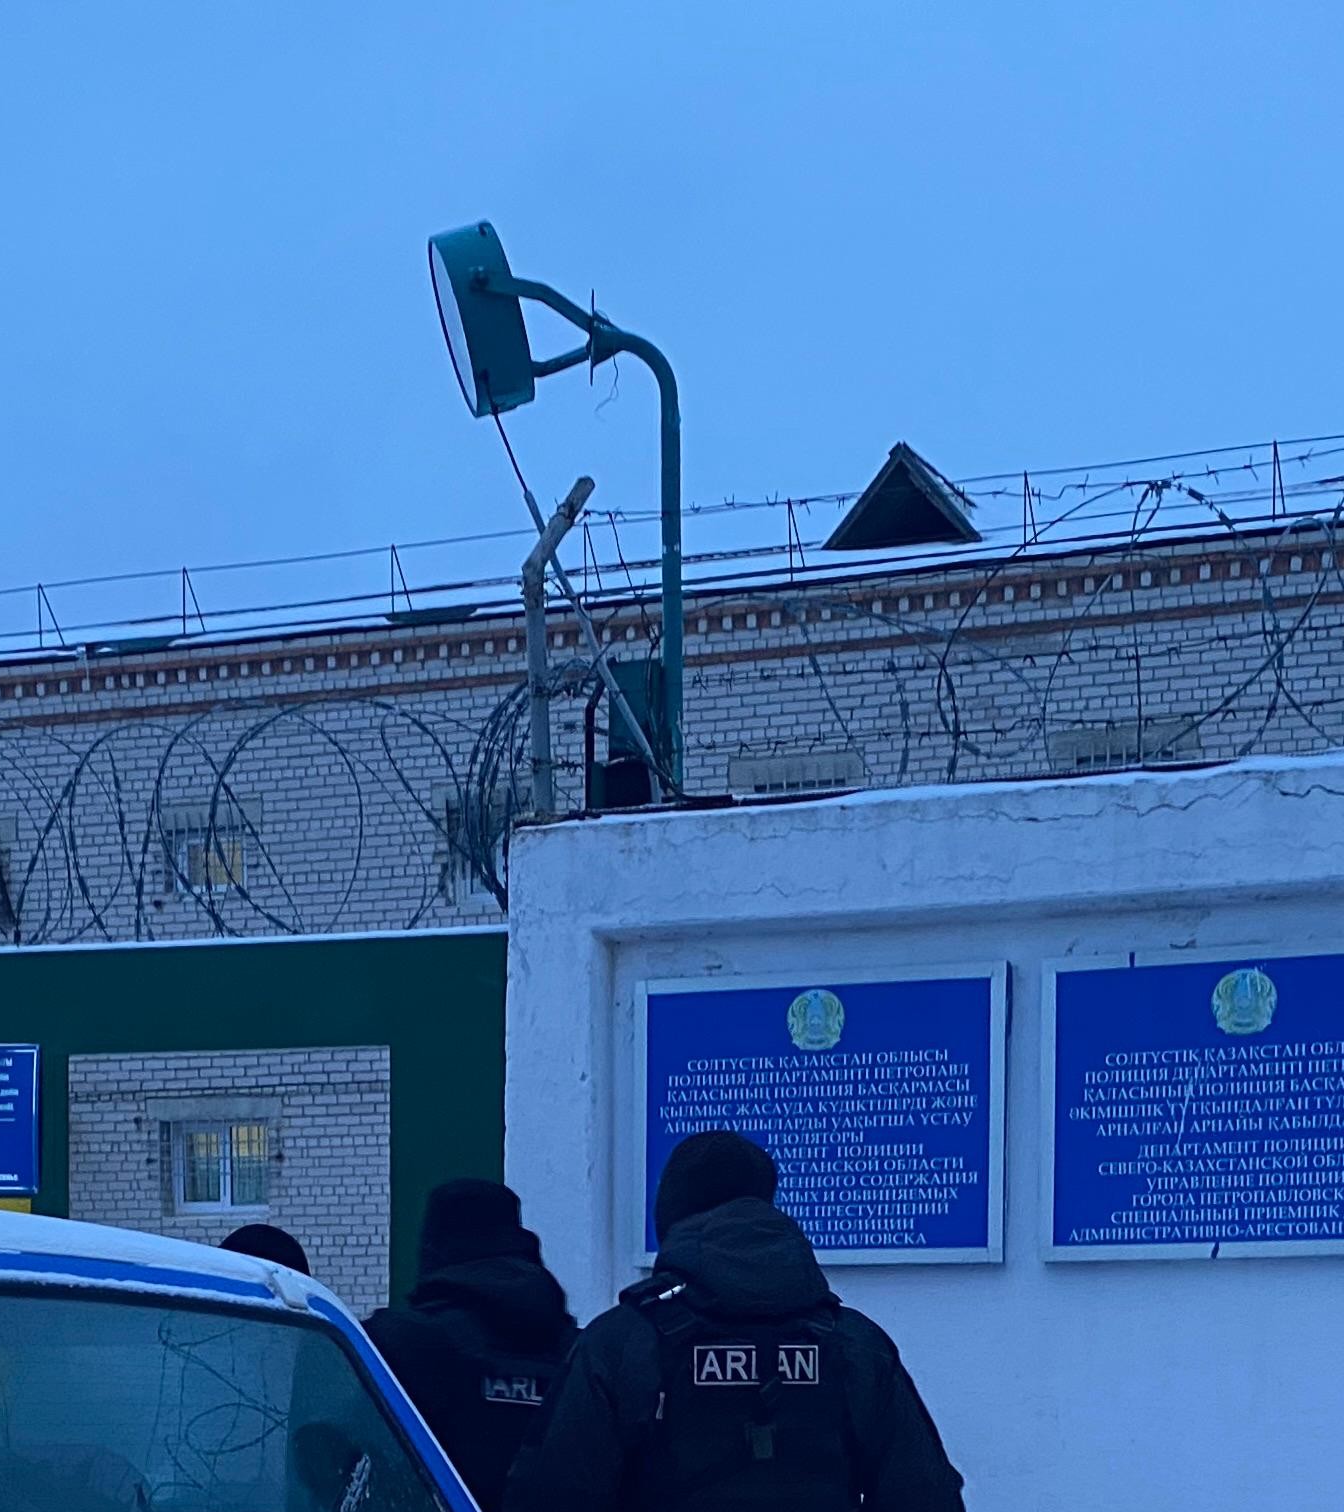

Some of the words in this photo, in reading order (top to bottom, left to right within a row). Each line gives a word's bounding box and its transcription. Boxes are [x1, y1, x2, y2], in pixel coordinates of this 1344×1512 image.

[779, 1052, 872, 1070] ҚАЗАҚСТАН
[876, 1049, 949, 1064] ОБЛЫСЫ
[1204, 1043, 1306, 1063] ҚАЗАҚСТАН
[668, 1073, 745, 1088] ПОЛИЦИЯ
[749, 1067, 869, 1086] ДЕПАРТАМЕНТІ
[874, 1063, 969, 1080] ПЕТРОПАВЛ
[1085, 1068, 1168, 1084] ПОЛИЦИЯ
[774, 1084, 853, 1099] ПОЛИЦИЯ
[858, 1079, 970, 1096] БАСҚАРМАСЫ
[1199, 1080, 1285, 1097] ПОЛИЦИЯ
[659, 1104, 731, 1119] ҚЫЛМЫС
[736, 1101, 813, 1117] ЖАСАУДА
[831, 1114, 915, 1131] УАҚЫТША
[1190, 1115, 1262, 1133] АРНАЙЫ
[767, 1131, 864, 1145] ИЗОЛЯТОРЫ
[837, 1143, 924, 1158] ПОЛИЦИИ
[1138, 1140, 1259, 1159] ДЕПАРТАМЕНТ
[883, 1157, 964, 1171] ОБЛАСТИ
[1098, 1154, 1308, 1176] СЕВЕРО-КАЗАХСТАНСКОЙ
[859, 1171, 978, 1188] СОДЕРЖАНИЯ
[1146, 1173, 1255, 1193] УПРАВЛЕНИЕ
[823, 1190, 834, 1203] И
[839, 1187, 959, 1202] ОБВИНЯЕМЫХ
[1132, 1193, 1195, 1208] ГОРОДА
[814, 1200, 949, 1218] ПРЕСТУПЛЕНИЙ
[1111, 1205, 1239, 1225] СПЕЦИАЛЬНЫЙ
[1244, 1204, 1339, 1221] ПРИЕМНИК
[828, 1217, 914, 1235] ПОЛИЦИИ
